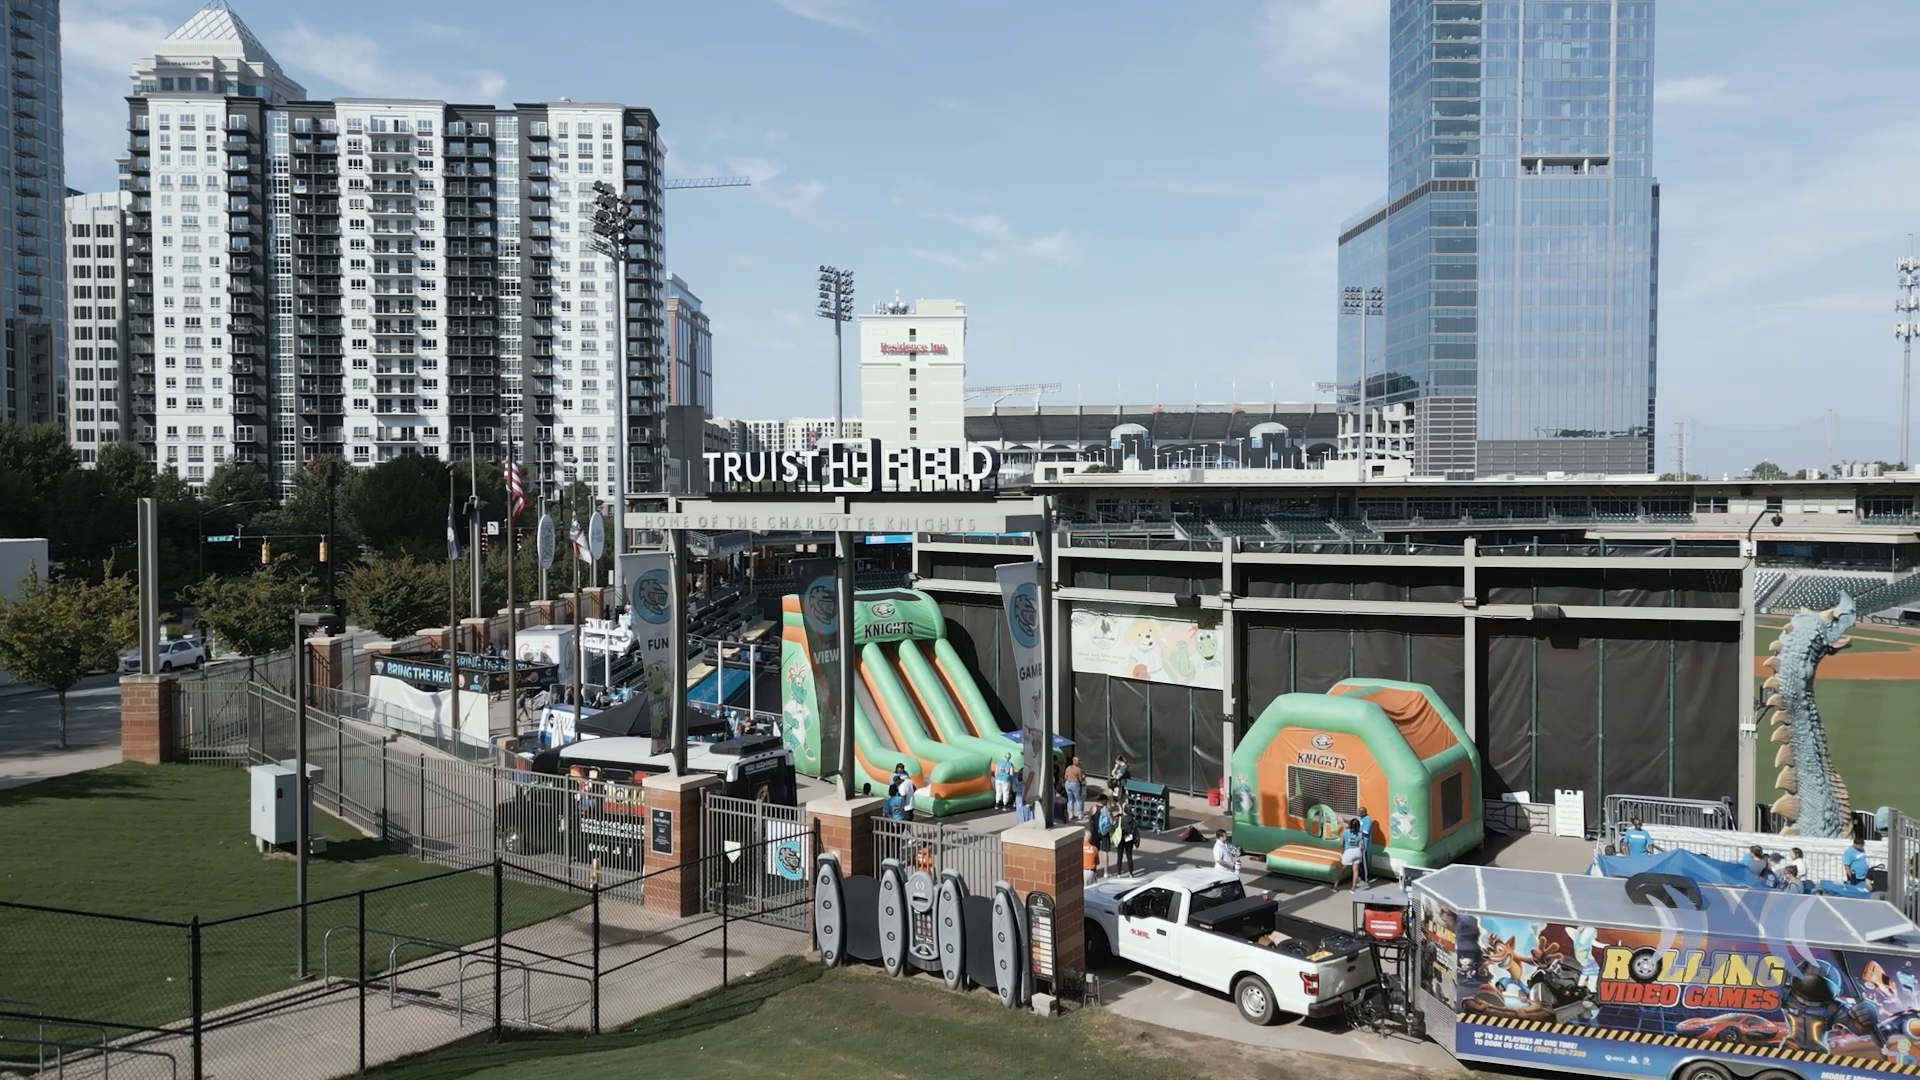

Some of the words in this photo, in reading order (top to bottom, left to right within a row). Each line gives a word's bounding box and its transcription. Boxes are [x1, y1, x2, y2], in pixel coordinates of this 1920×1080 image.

[880, 342, 928, 352] Residence
[930, 343, 947, 352] Inn
[702, 451, 820, 483] TRUIST
[881, 447, 995, 481] FIELD
[645, 516, 690, 528] HOME
[698, 516, 718, 528] OF
[727, 516, 758, 529] THE
[768, 516, 876, 530] CHARLOTTE
[884, 517, 977, 531] KNIGHTS
[865, 622, 914, 638] KNIGHTS
[647, 638, 669, 650] FUN
[814, 648, 840, 664] VIEW
[386, 662, 412, 679] BRING
[413, 666, 431, 682] THE
[1020, 663, 1042, 681] GAME
[1297, 752, 1347, 770] KNIGHTS
[1601, 947, 1786, 988] ROLLING
[1600, 981, 1678, 1005] VIDEO
[1684, 985, 1780, 1011] GAMES
[1474, 1031, 1484, 1039] UP
[1485, 1032, 1494, 1040] TO
[1504, 1035, 1533, 1045] PLAYERS
[1474, 1038, 1483, 1046] TO
[1484, 1039, 1503, 1048] BOOK
[1503, 1041, 1513, 1049] US
[1514, 1043, 1533, 1052] CALL:
